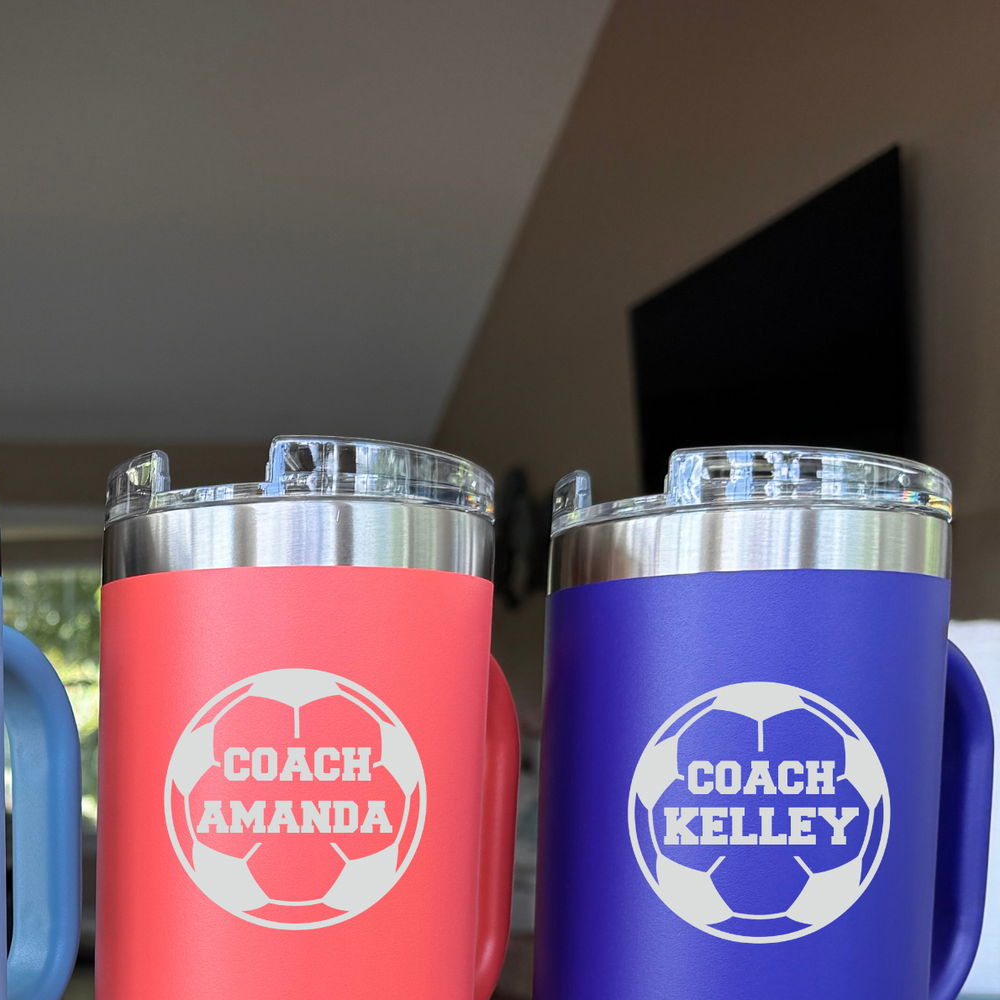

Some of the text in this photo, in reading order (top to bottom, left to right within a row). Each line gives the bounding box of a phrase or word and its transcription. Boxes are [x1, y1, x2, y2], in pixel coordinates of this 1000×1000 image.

[223, 746, 372, 782] COACH
[687, 760, 836, 795] COACH
[196, 800, 393, 834] AMANDA
[663, 807, 860, 846] KELLEY
